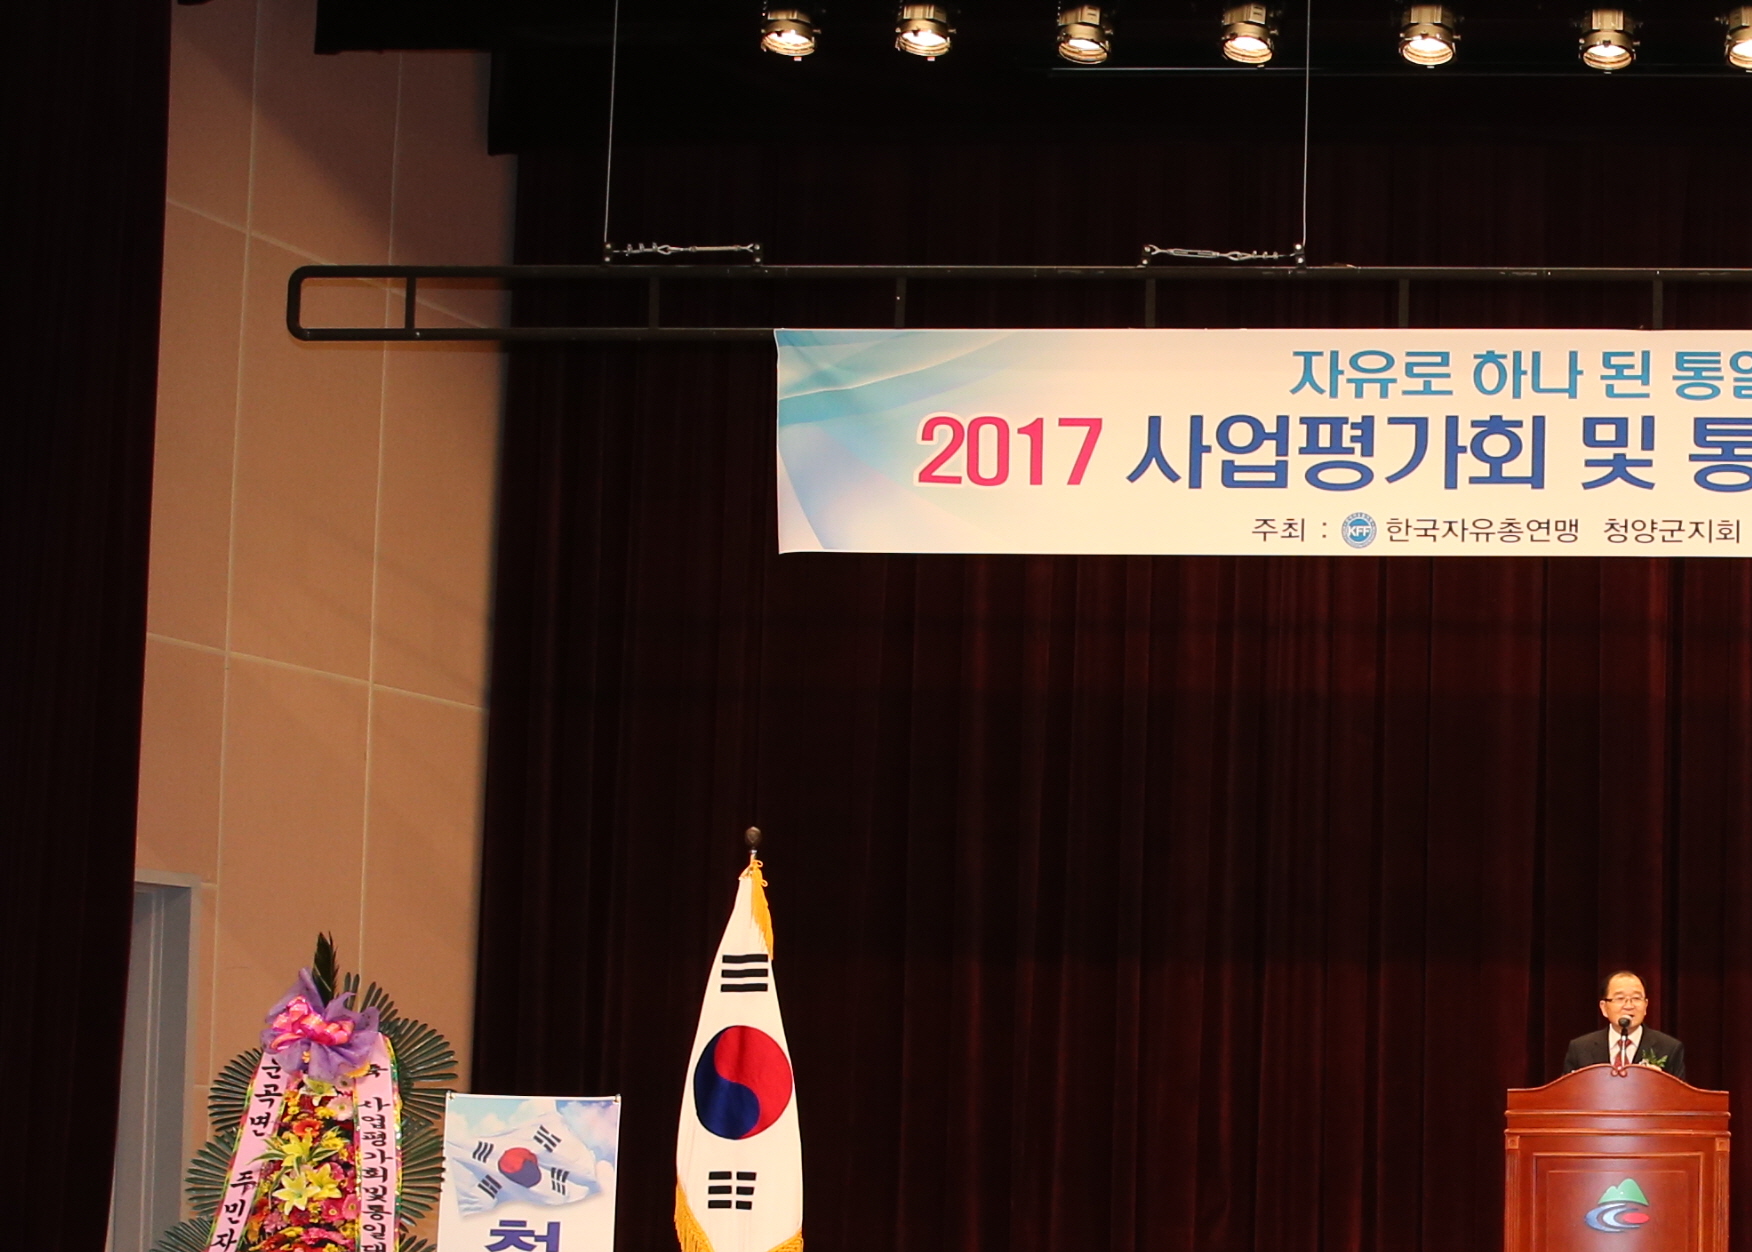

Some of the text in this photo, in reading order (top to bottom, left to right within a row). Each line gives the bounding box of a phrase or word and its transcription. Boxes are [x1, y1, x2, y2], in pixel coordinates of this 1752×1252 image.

[1290, 350, 1454, 399] 자유로
[1473, 350, 1584, 399] 하나
[1599, 350, 1651, 399] 된
[916, 415, 1103, 487] 2017
[1125, 413, 1546, 492] 사업평가회
[1580, 414, 1656, 491] 및
[1251, 517, 1305, 543] 주최
[1386, 517, 1579, 544] 한국자유총연맹
[1603, 518, 1741, 544] 청양군지회
[1348, 525, 1372, 537] KFF
